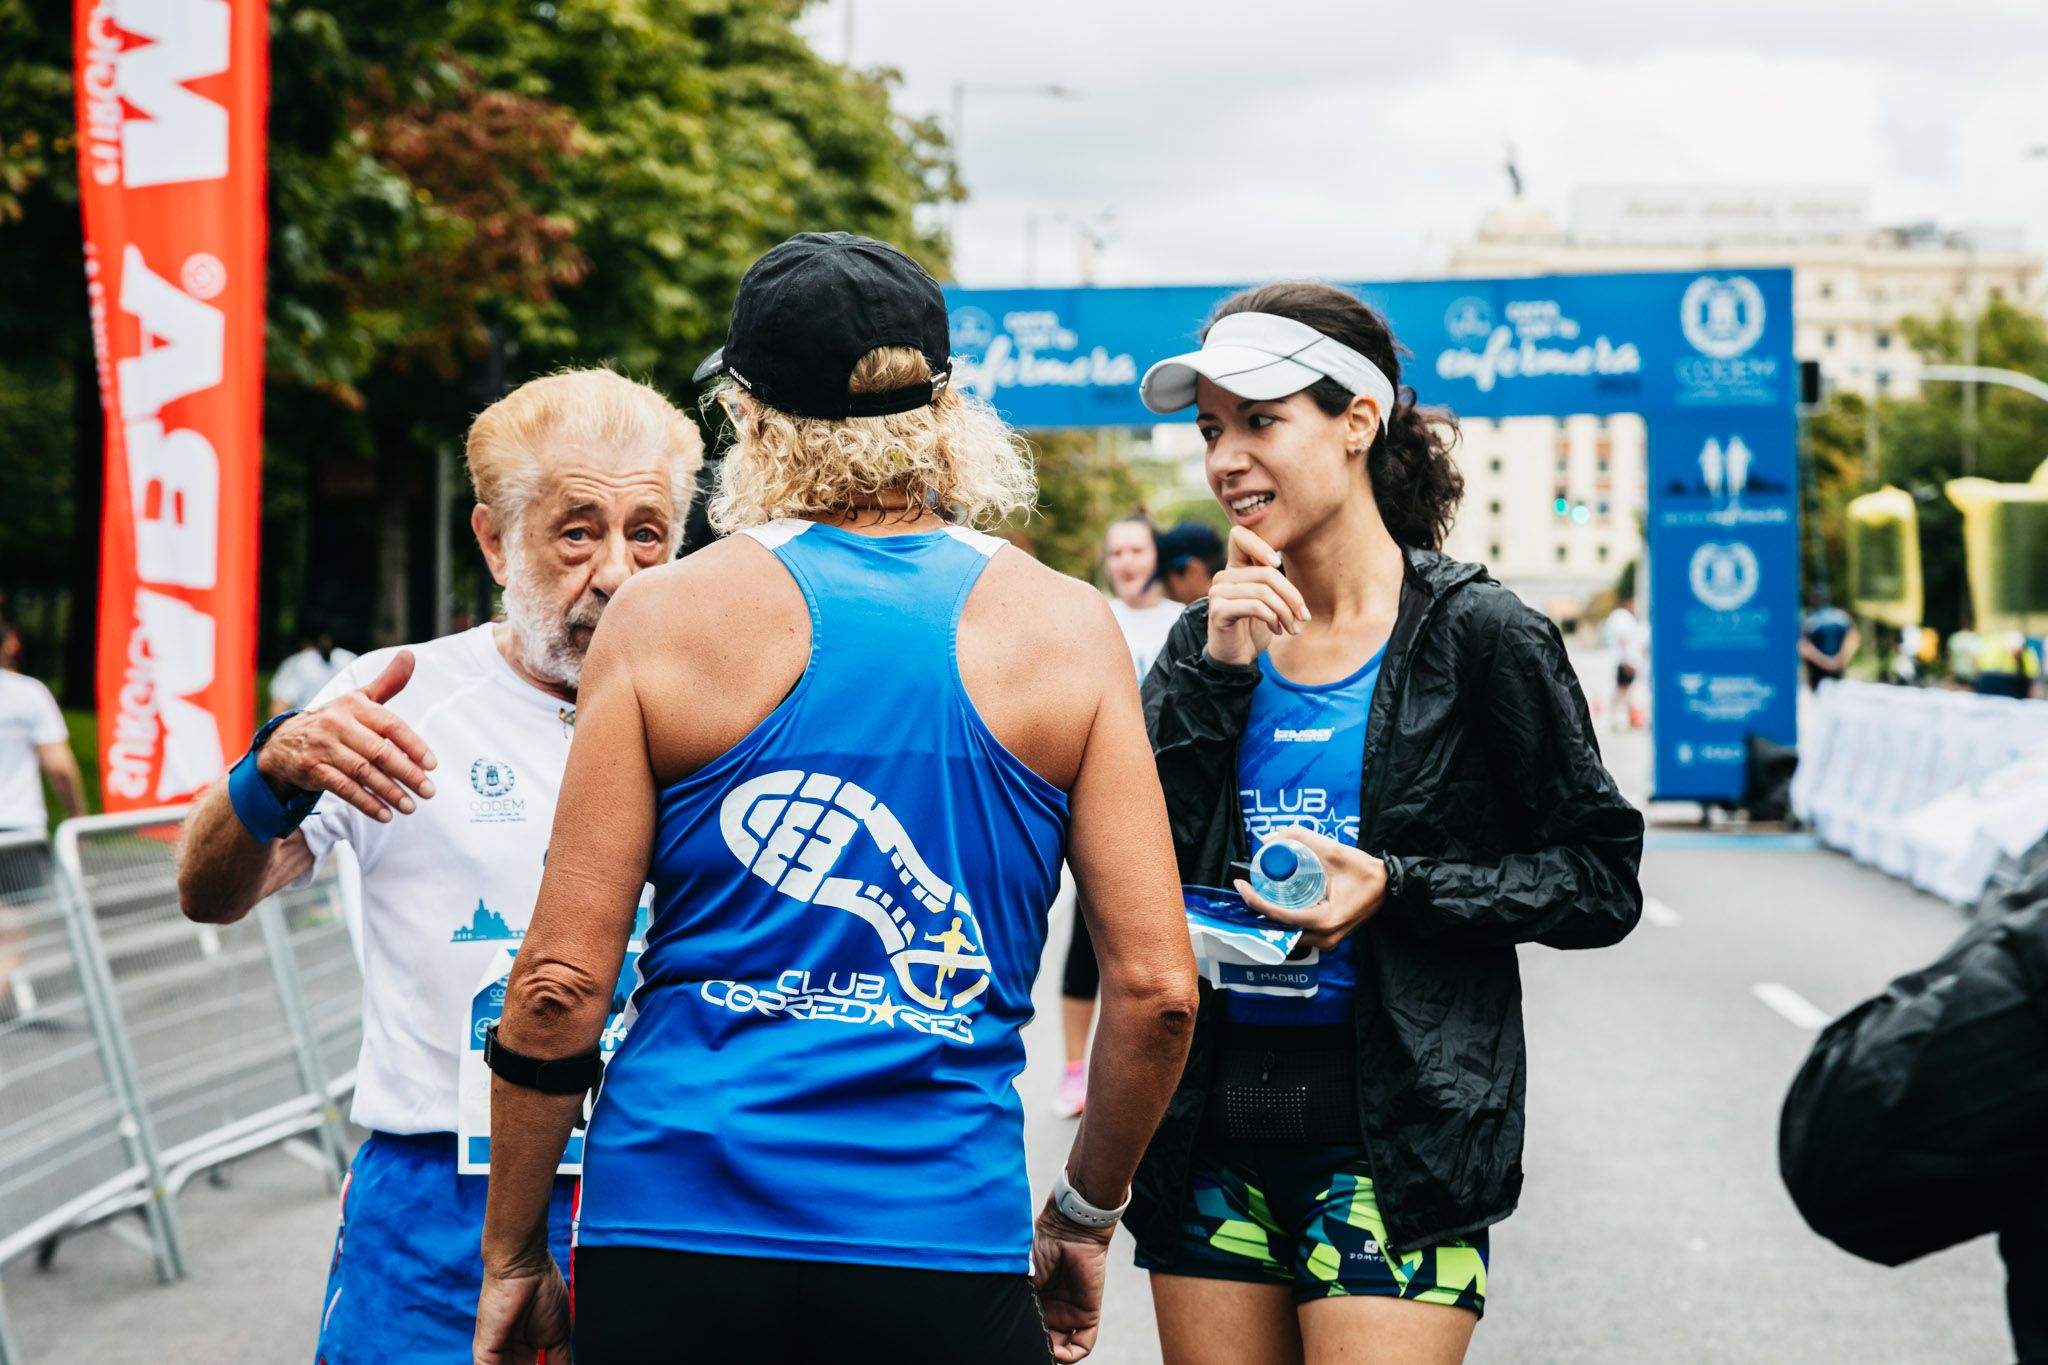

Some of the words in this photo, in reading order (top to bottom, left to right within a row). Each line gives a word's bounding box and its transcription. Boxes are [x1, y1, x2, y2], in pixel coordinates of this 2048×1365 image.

[469, 799, 525, 811] CODEM
[1261, 973, 1309, 983] MADRID
[776, 970, 886, 999] CLUB
